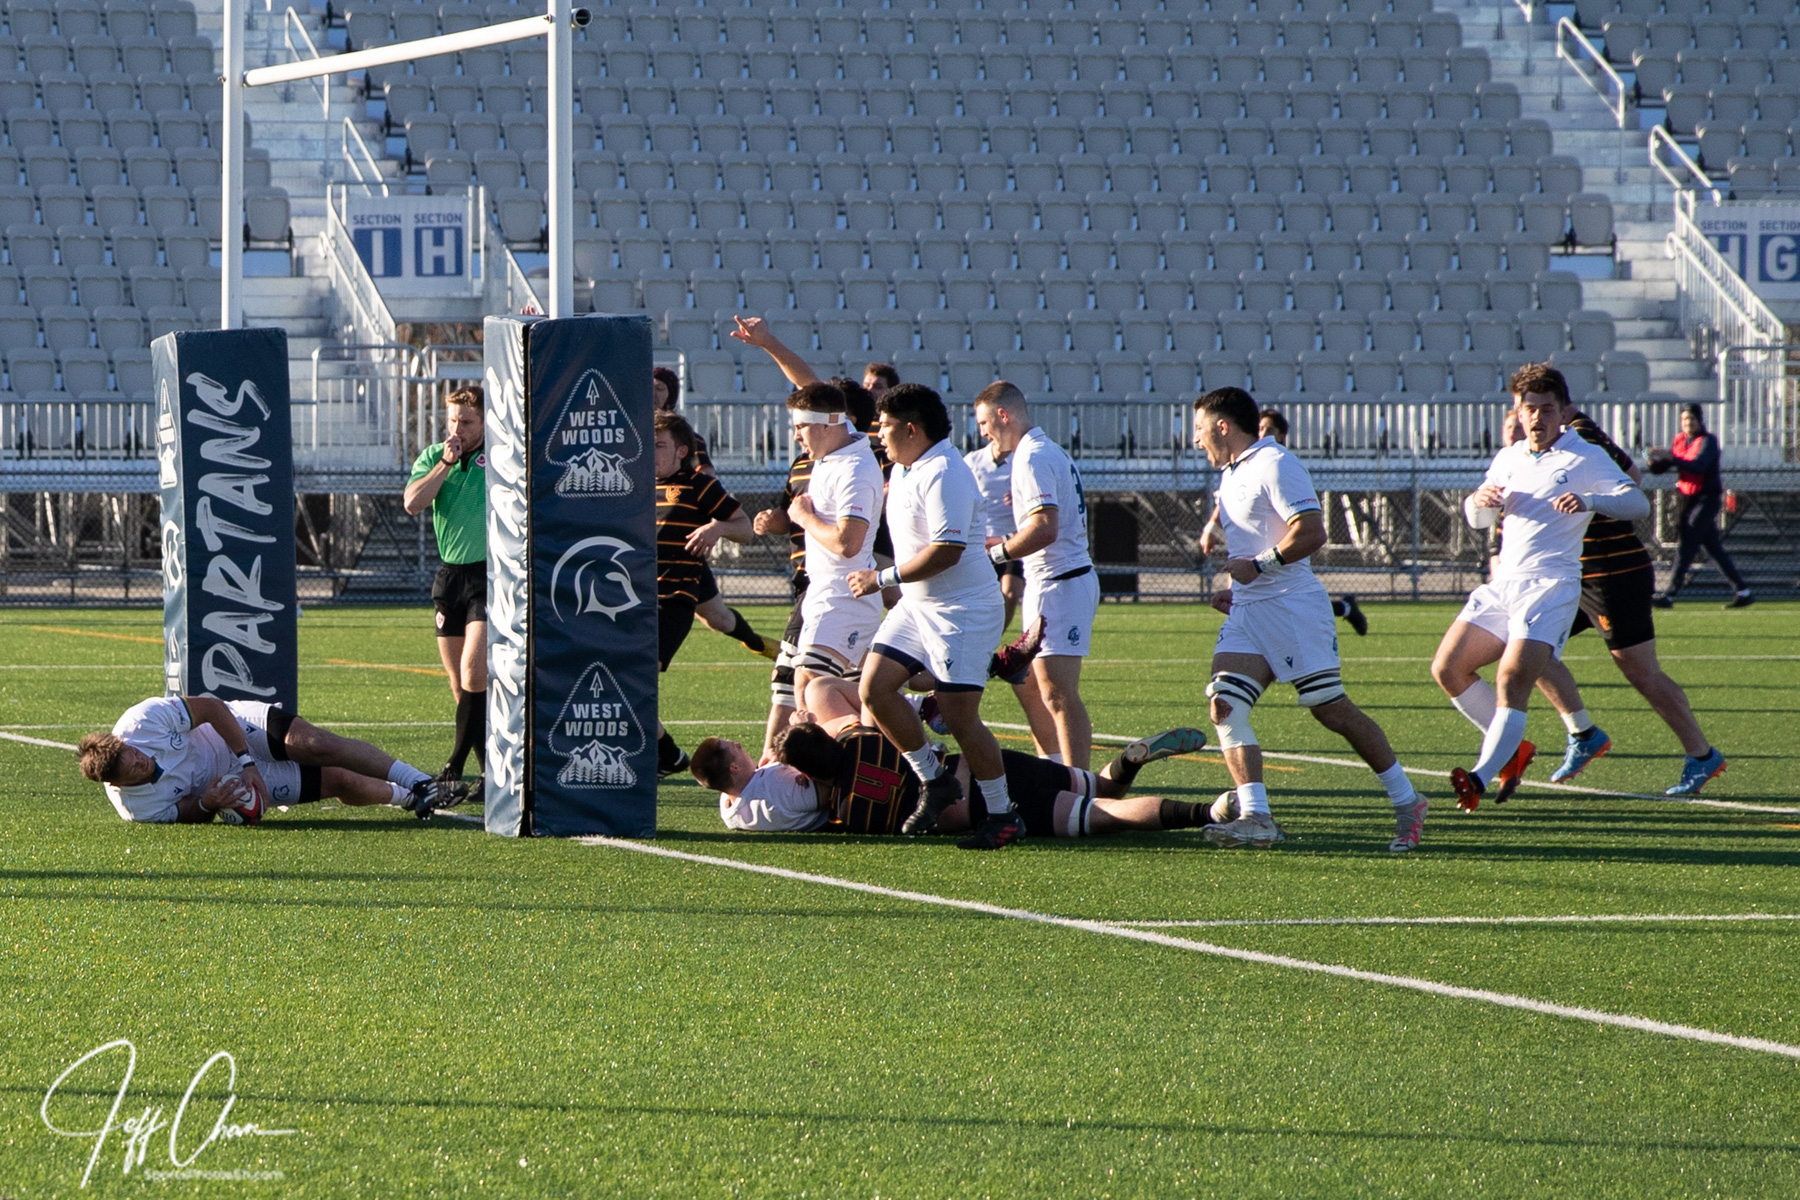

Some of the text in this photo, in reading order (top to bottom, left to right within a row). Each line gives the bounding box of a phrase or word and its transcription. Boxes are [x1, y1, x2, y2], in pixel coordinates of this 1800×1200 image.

[353, 214, 402, 225] SECTION
[414, 213, 463, 224] SECTION
[1700, 221, 1747, 230] SECTION
[372, 230, 384, 275] I
[422, 229, 456, 274] H
[1765, 236, 1798, 281] G
[569, 410, 618, 427] WEST
[562, 428, 625, 446] WOODS
[186, 371, 285, 699] PARTANS
[572, 703, 622, 719] WEST
[565, 721, 629, 737] WOODS
